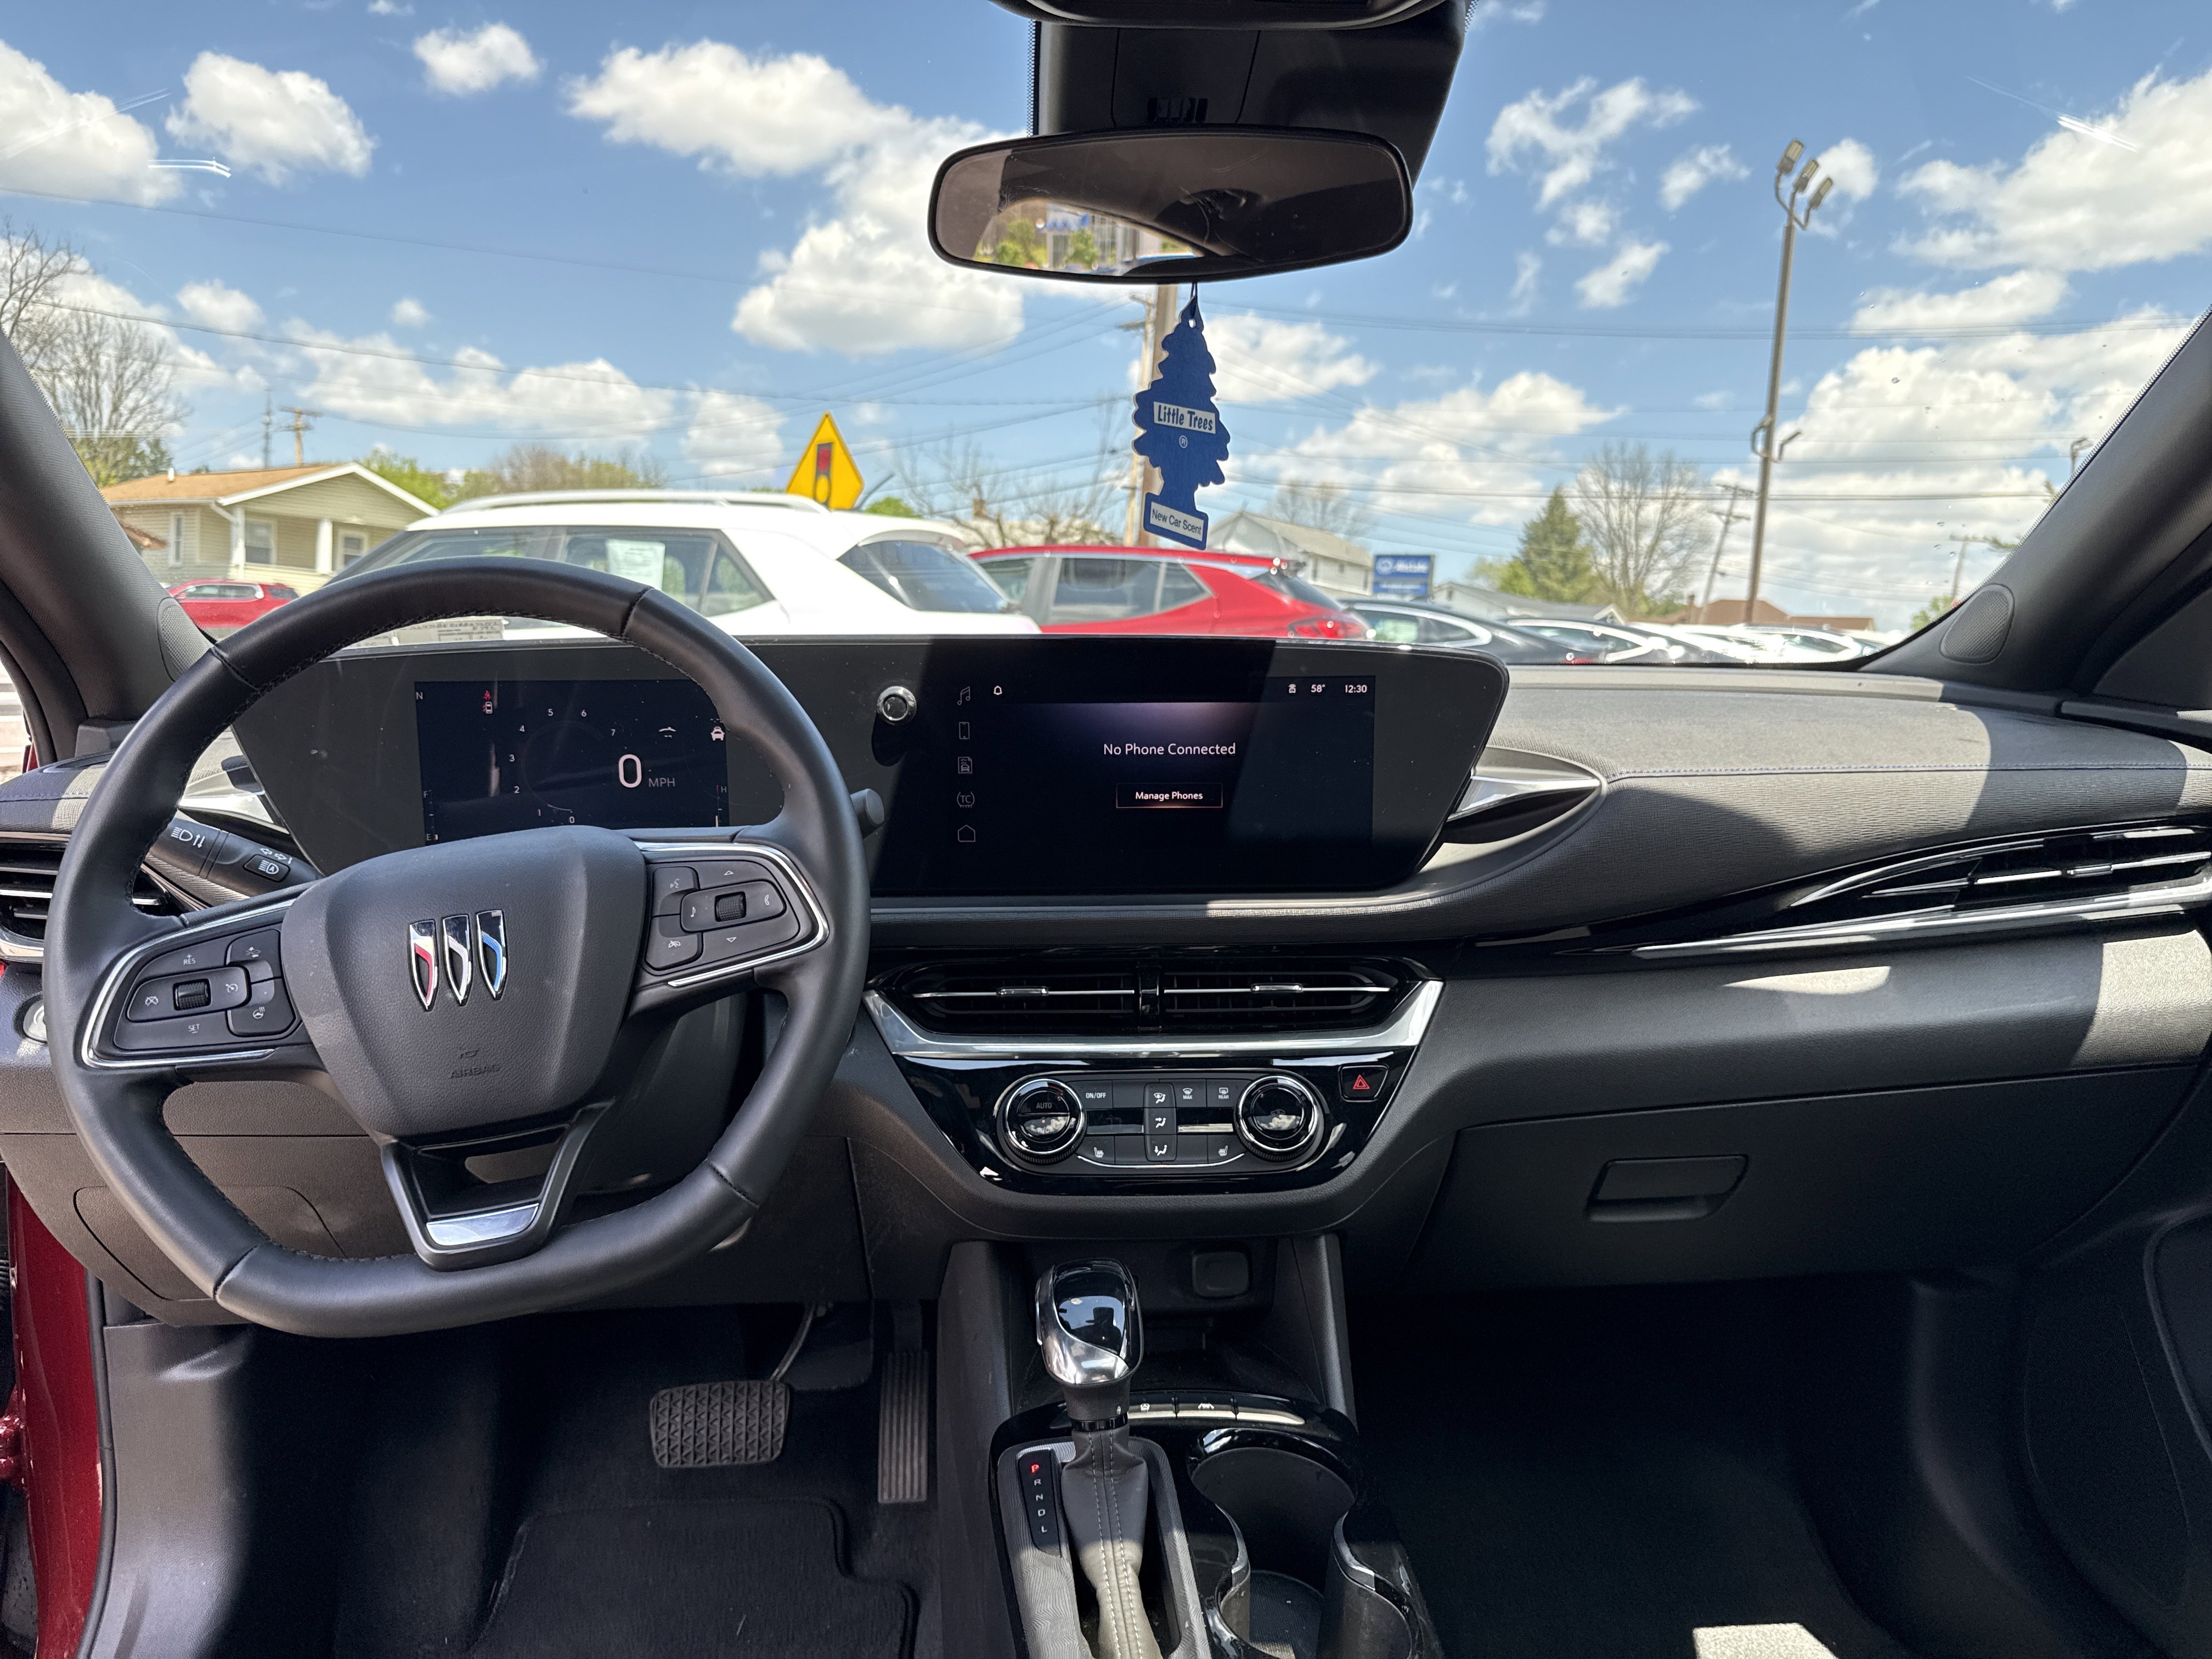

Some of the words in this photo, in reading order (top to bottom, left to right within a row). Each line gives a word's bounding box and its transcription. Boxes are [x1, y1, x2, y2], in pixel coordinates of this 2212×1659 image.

[1158, 404, 1184, 426] Little
[1187, 410, 1213, 431] Trees
[1152, 508, 1167, 523] New
[1169, 514, 1182, 528] Car
[1182, 520, 1202, 535] Scent
[1345, 685, 1367, 693] 12:30
[415, 691, 423, 700] N
[548, 708, 554, 716] 5
[581, 709, 587, 718] 6
[519, 725, 526, 733] 4
[610, 728, 616, 737] 7
[1104, 743, 1121, 755] No
[1125, 743, 1165, 755] Phone
[1168, 742, 1236, 755] Connected
[509, 754, 515, 763] 3
[618, 754, 642, 788] 0
[648, 777, 675, 788] MPH
[514, 786, 520, 794] 2
[1135, 792, 1170, 802] Manage
[1171, 791, 1203, 800] Phones
[569, 816, 575, 824] 0
[188, 1024, 200, 1032] SET
[1031, 1464, 1040, 1474] P
[1035, 1493, 1043, 1502] N
[1037, 1509, 1046, 1517] D
